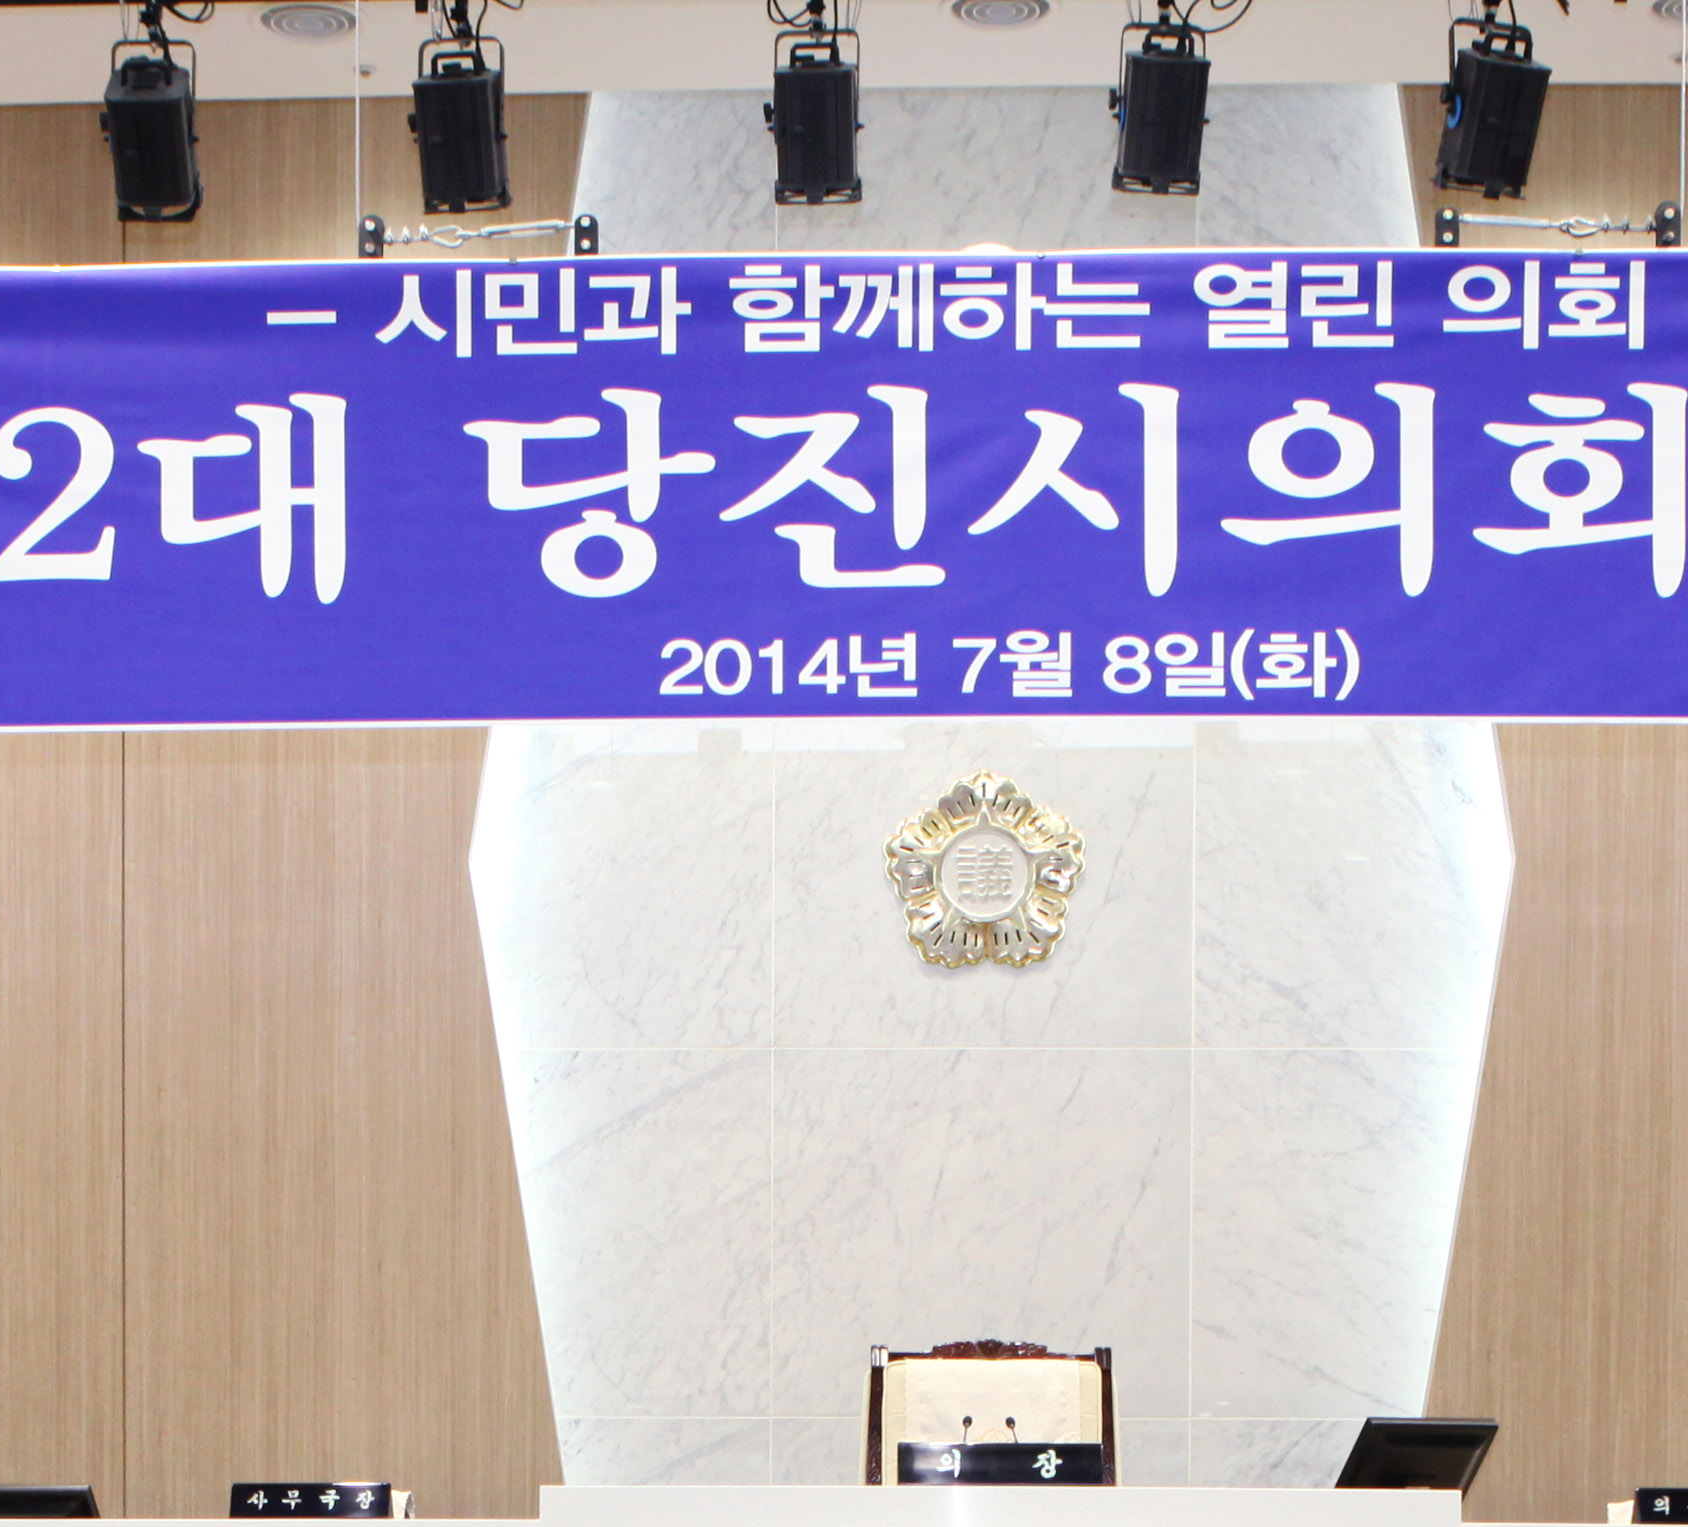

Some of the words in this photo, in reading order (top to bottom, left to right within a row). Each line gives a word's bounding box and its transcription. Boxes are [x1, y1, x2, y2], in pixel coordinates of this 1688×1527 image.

[374, 262, 690, 357] 시민과
[728, 258, 1150, 354] 함께하는
[1193, 260, 1394, 350] 열린
[1442, 258, 1646, 350] 의회
[463, 383, 1688, 597] 당진시의회
[659, 633, 918, 699] 2014년
[952, 630, 1073, 699] 7월
[1103, 628, 1360, 702] 8일(화)
